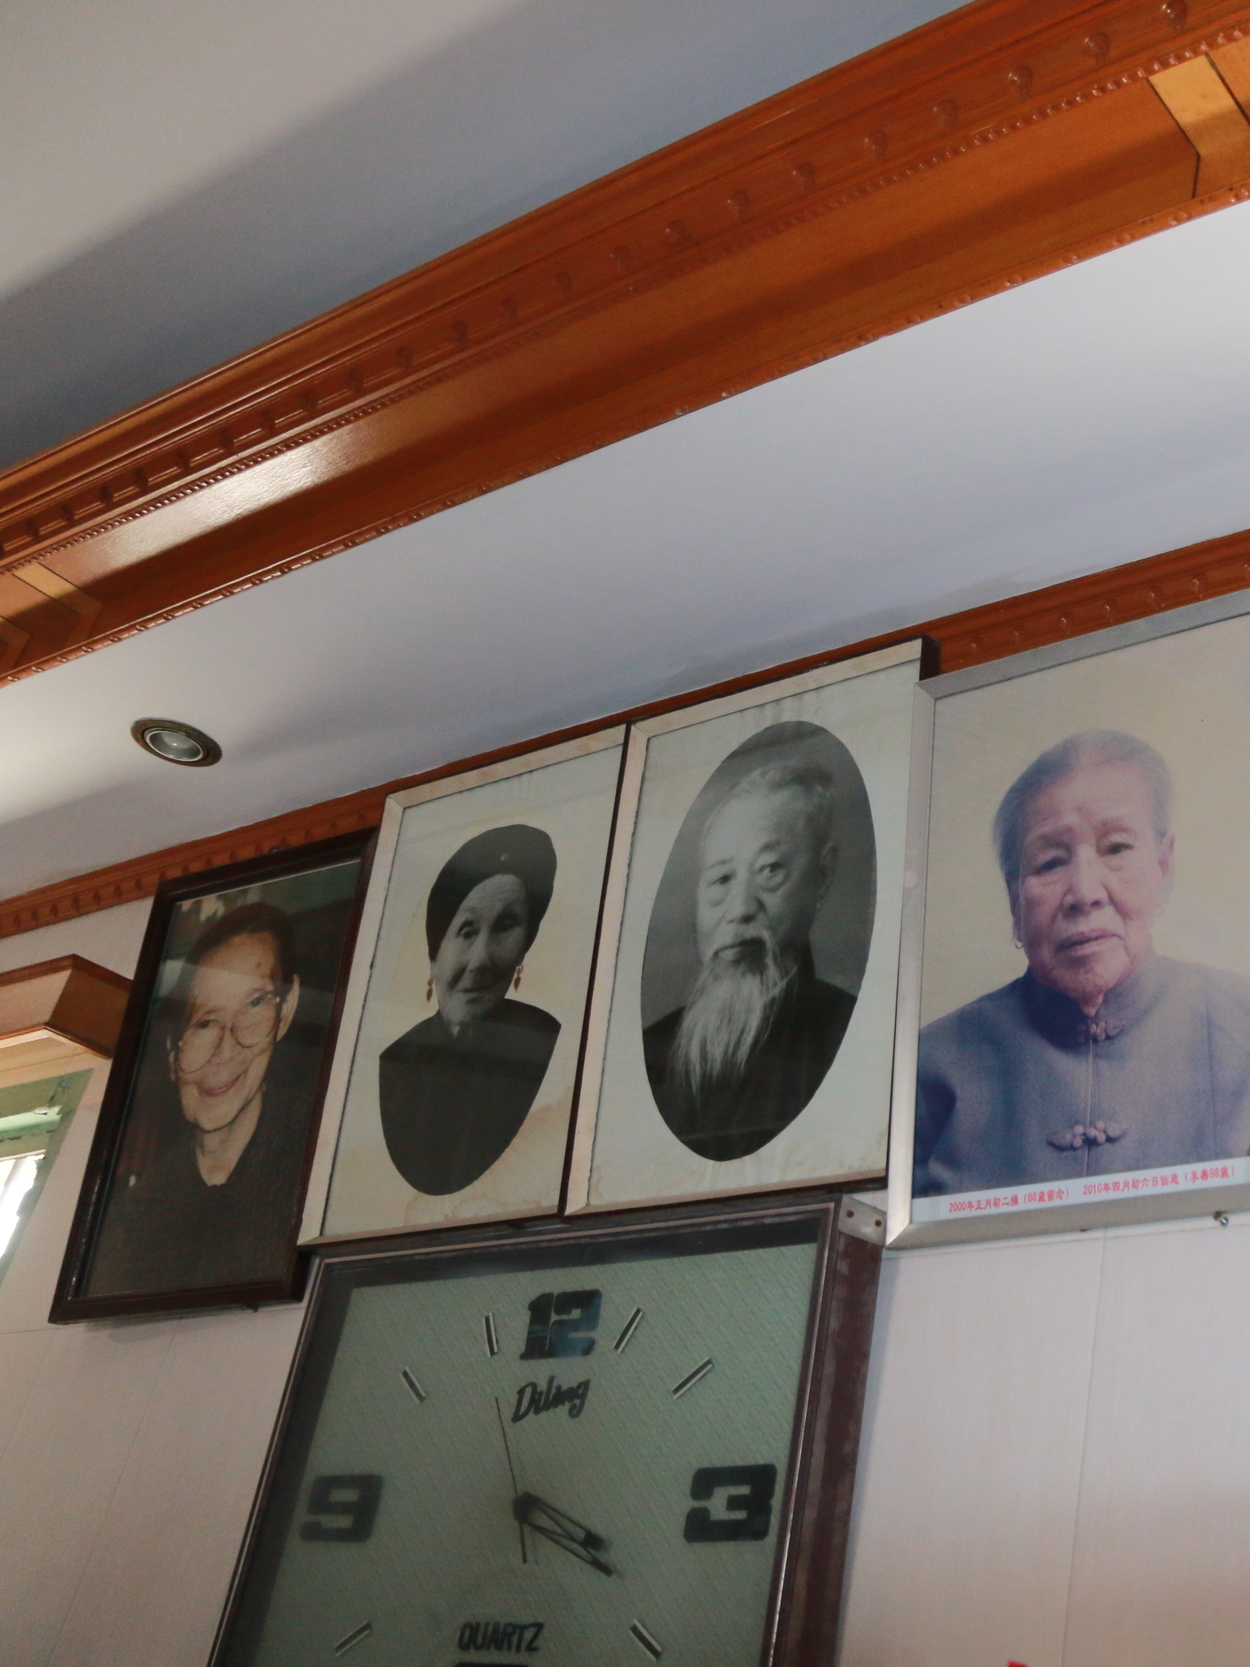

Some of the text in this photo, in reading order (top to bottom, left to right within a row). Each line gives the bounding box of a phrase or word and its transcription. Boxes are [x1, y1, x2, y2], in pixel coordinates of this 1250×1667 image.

[519, 1289, 602, 1360] 12
[300, 1474, 383, 1542] 9
[683, 1464, 777, 1543] 3
[457, 1621, 544, 1654] QUARTZ
